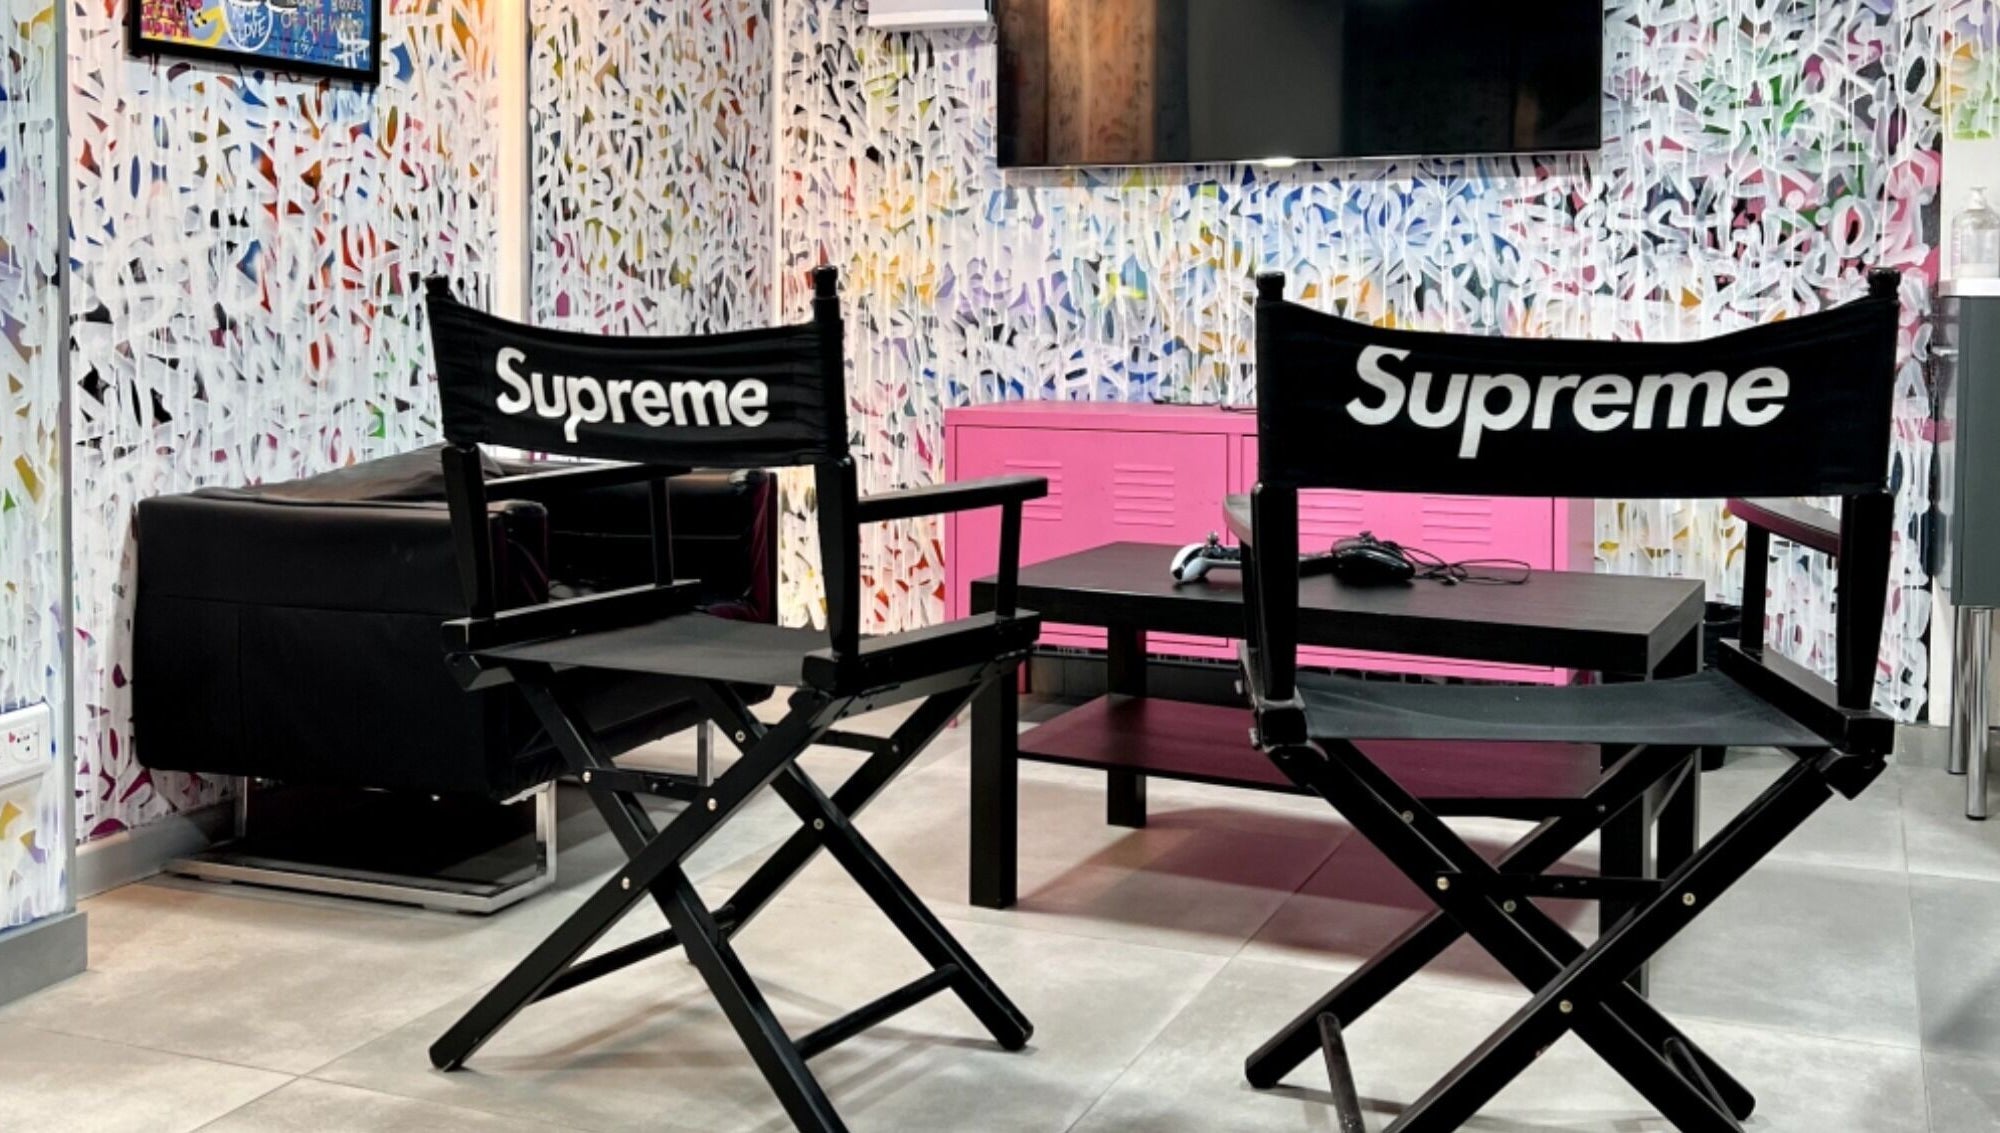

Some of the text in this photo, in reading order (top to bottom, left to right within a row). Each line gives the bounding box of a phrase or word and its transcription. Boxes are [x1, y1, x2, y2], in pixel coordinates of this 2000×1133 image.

[238, 15, 266, 42] LOVE
[495, 347, 769, 443] Supreme
[1345, 344, 1790, 459] Supreme
